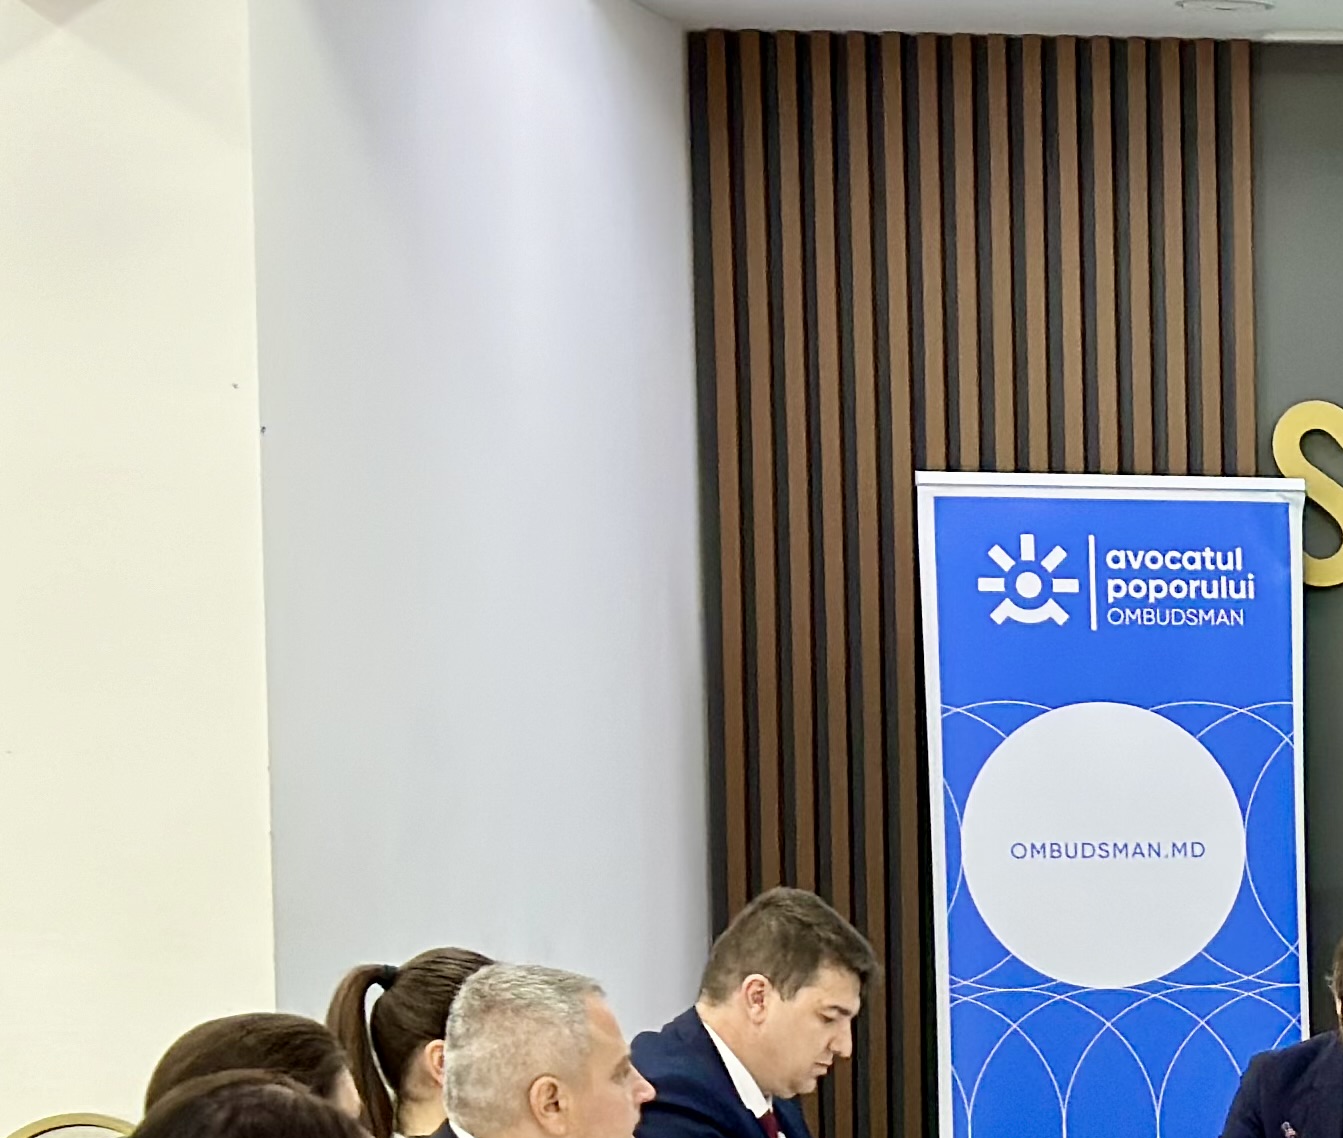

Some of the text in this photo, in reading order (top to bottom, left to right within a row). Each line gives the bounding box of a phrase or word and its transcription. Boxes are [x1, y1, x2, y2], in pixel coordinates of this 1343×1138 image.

[1105, 546, 1243, 571] avocatul
[1107, 572, 1255, 604] poporului
[1107, 607, 1244, 626] OMBUDSMAN
[1010, 841, 1206, 860] OMBUDSMAN.MD
